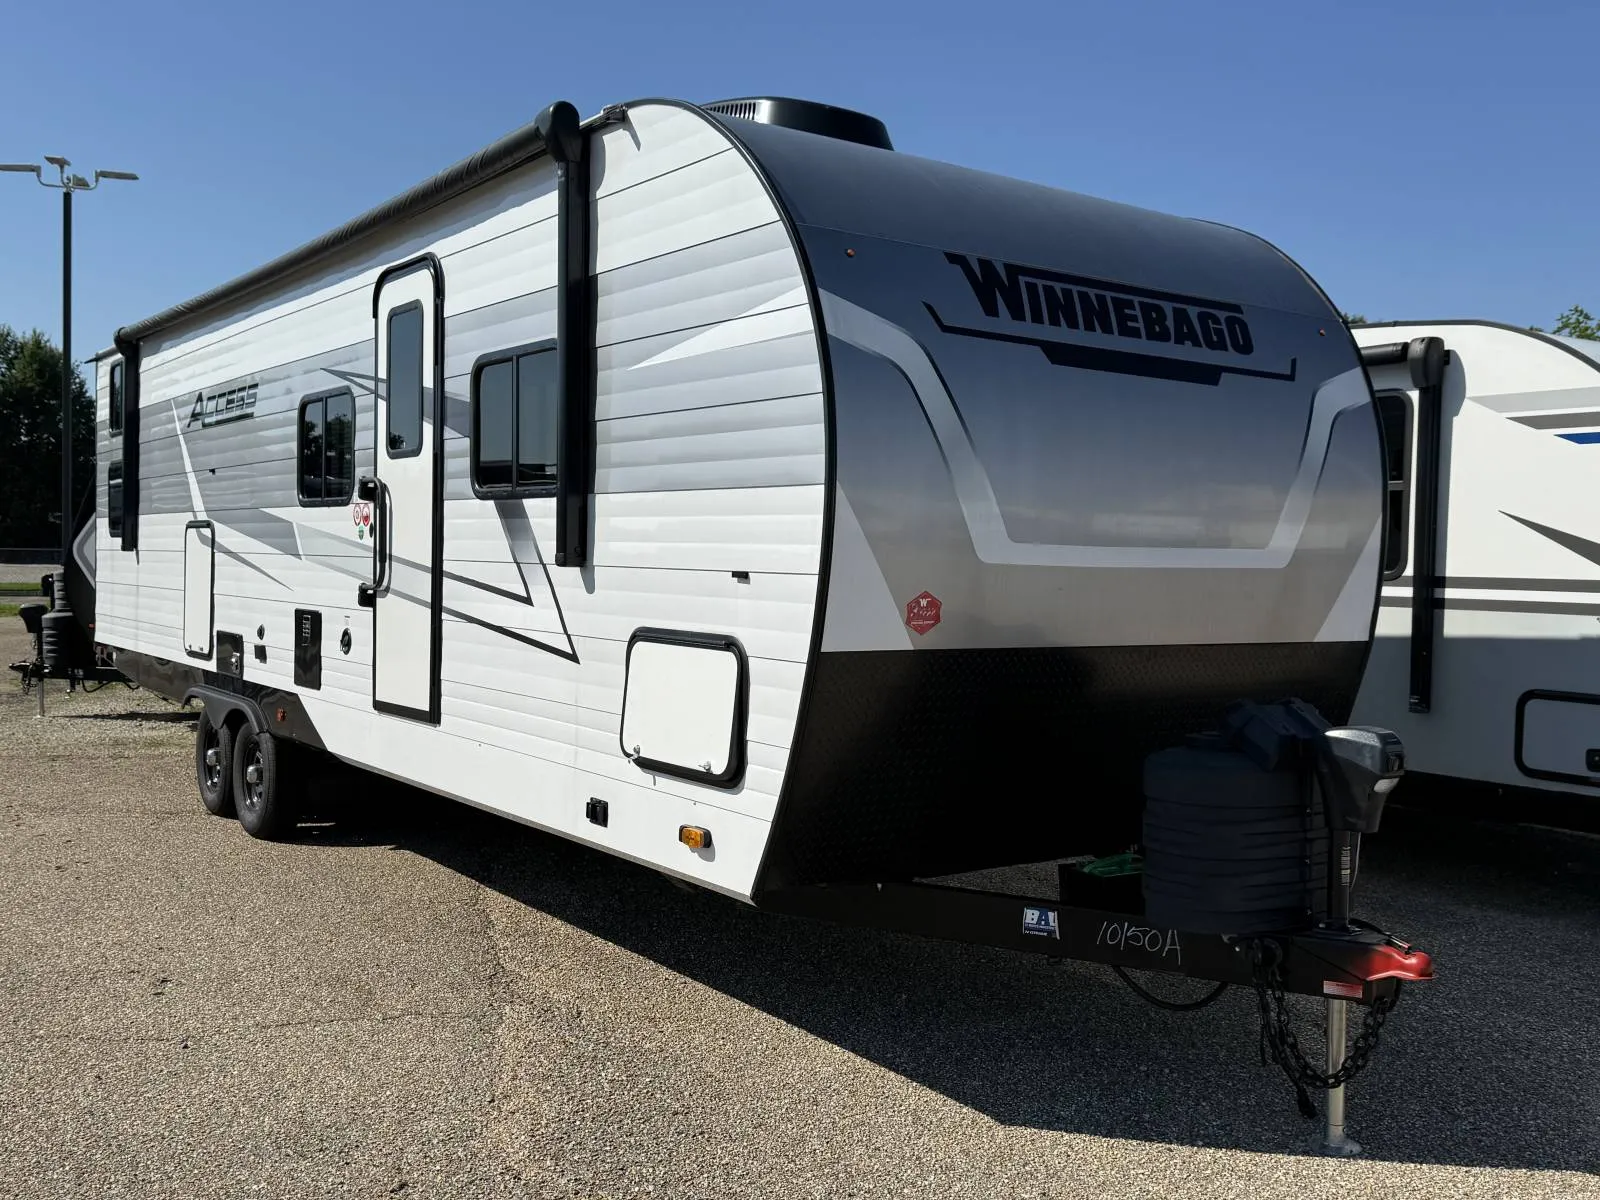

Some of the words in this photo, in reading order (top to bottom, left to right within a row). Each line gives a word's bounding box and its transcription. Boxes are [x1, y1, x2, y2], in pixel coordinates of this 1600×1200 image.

[943, 251, 1254, 356] WINNEBAGO
[187, 383, 259, 428] ACCESS
[1096, 920, 1181, 966] 10150A
